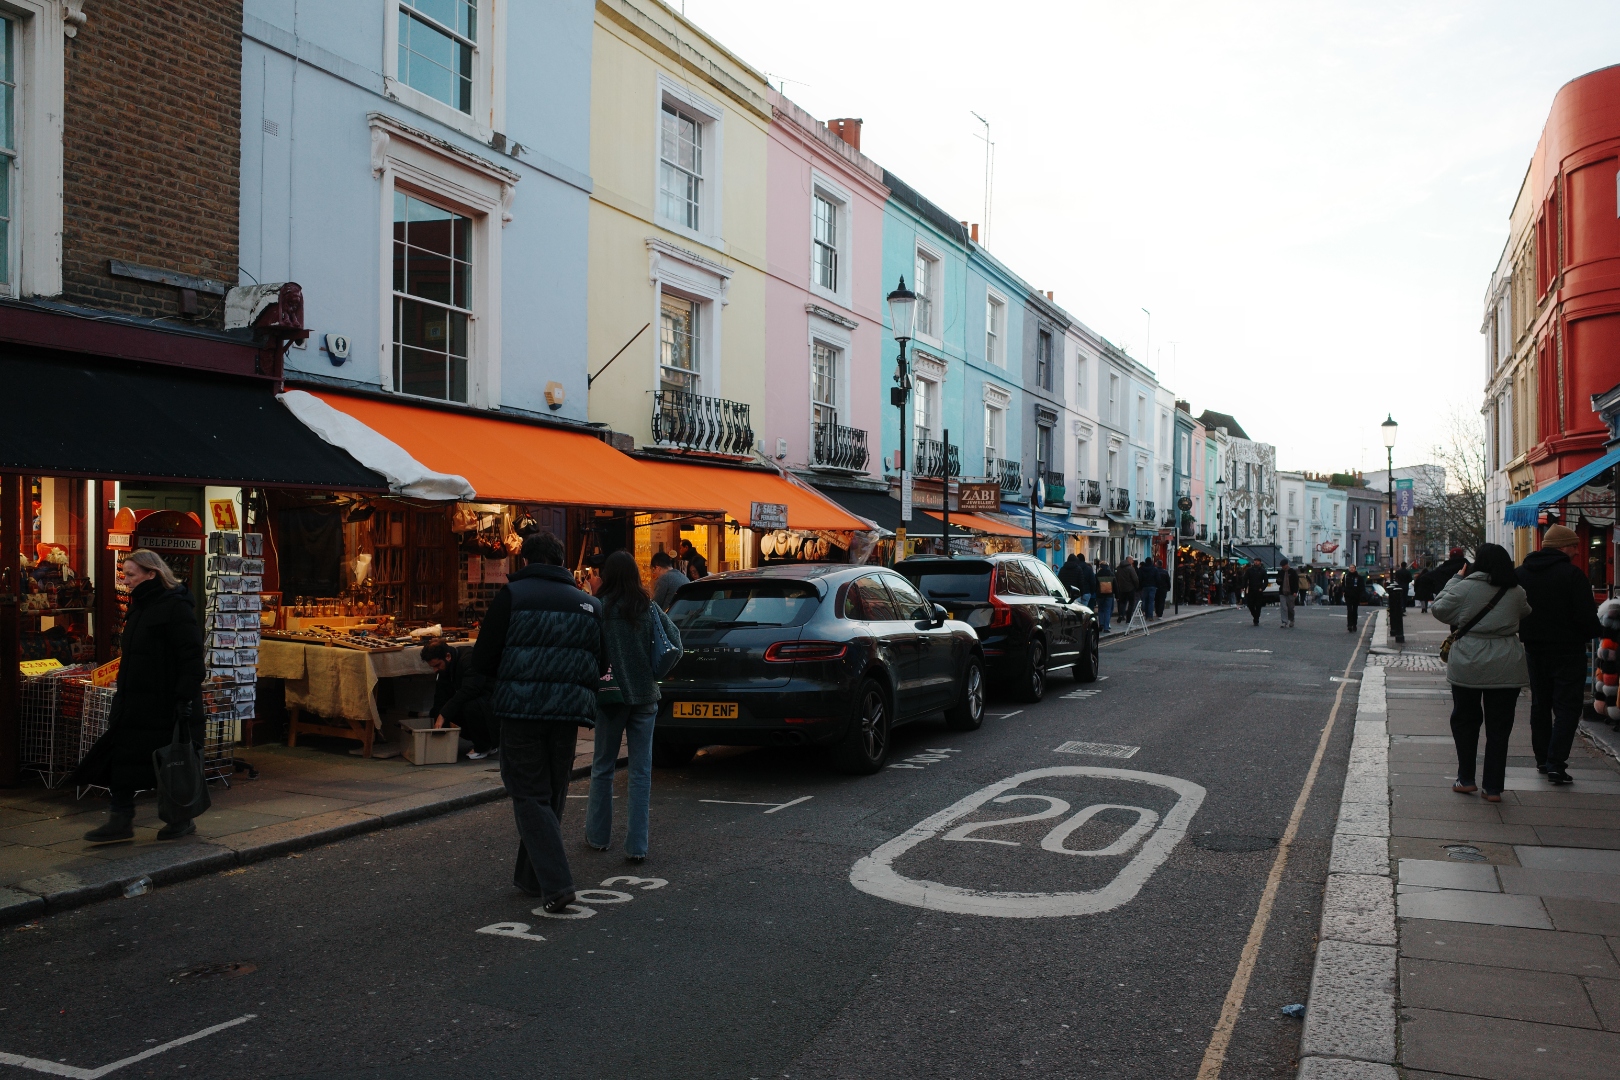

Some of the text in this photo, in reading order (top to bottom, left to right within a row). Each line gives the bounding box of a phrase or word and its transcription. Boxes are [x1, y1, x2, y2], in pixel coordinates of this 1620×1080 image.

[961, 490, 995, 501] ZABI
[1401, 490, 1410, 512] Shop
[214, 503, 235, 526] £1
[762, 504, 777, 514] SALE
[142, 537, 197, 549] TELEPHONE
[20, 661, 47, 669] £2.99
[97, 662, 120, 678] £1.99
[680, 703, 736, 717] LJ67 ENF
[941, 794, 1159, 856] 20
